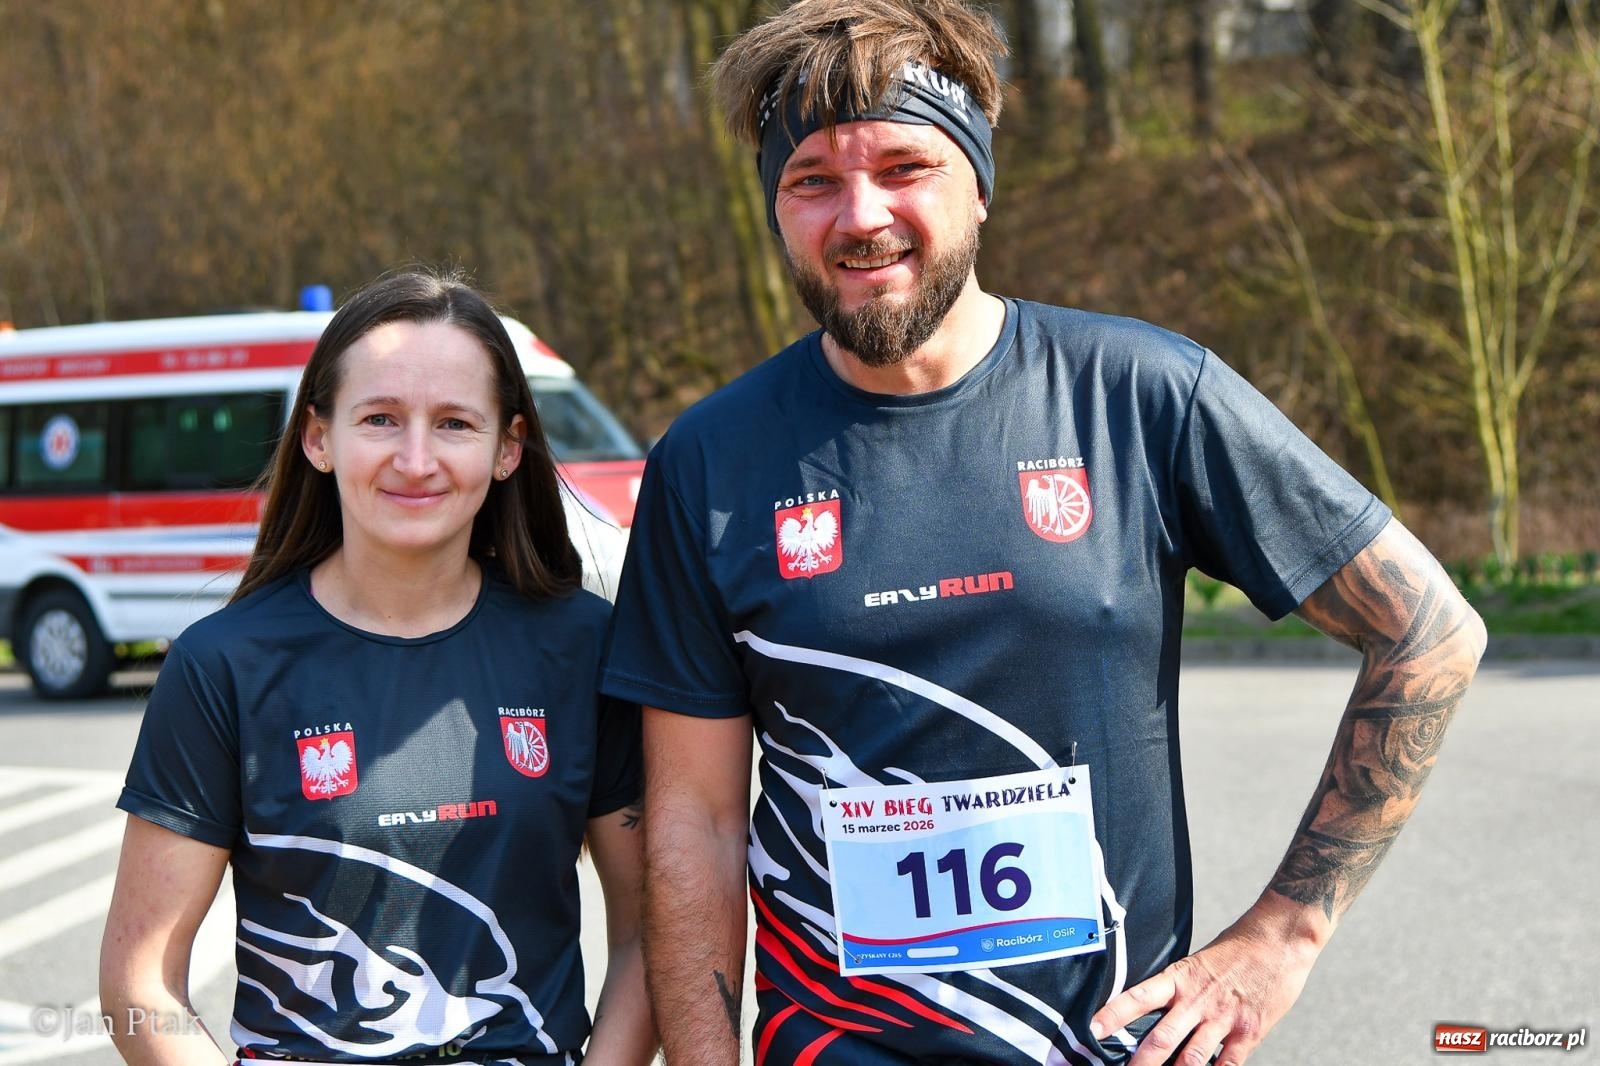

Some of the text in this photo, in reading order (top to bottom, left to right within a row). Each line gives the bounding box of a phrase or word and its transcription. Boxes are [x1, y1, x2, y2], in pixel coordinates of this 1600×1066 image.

[1017, 457, 1085, 471] RACIBÓRZ
[774, 488, 840, 510] POLSKA
[498, 707, 545, 718] RACIBÓRZ
[294, 722, 353, 739] POLSKA
[840, 783, 1071, 819] XIV BIEG TWARDZIELA
[842, 819, 935, 834] 15 marzec 2026
[896, 842, 1032, 919] 116
[996, 934, 1043, 948] Racibórz
